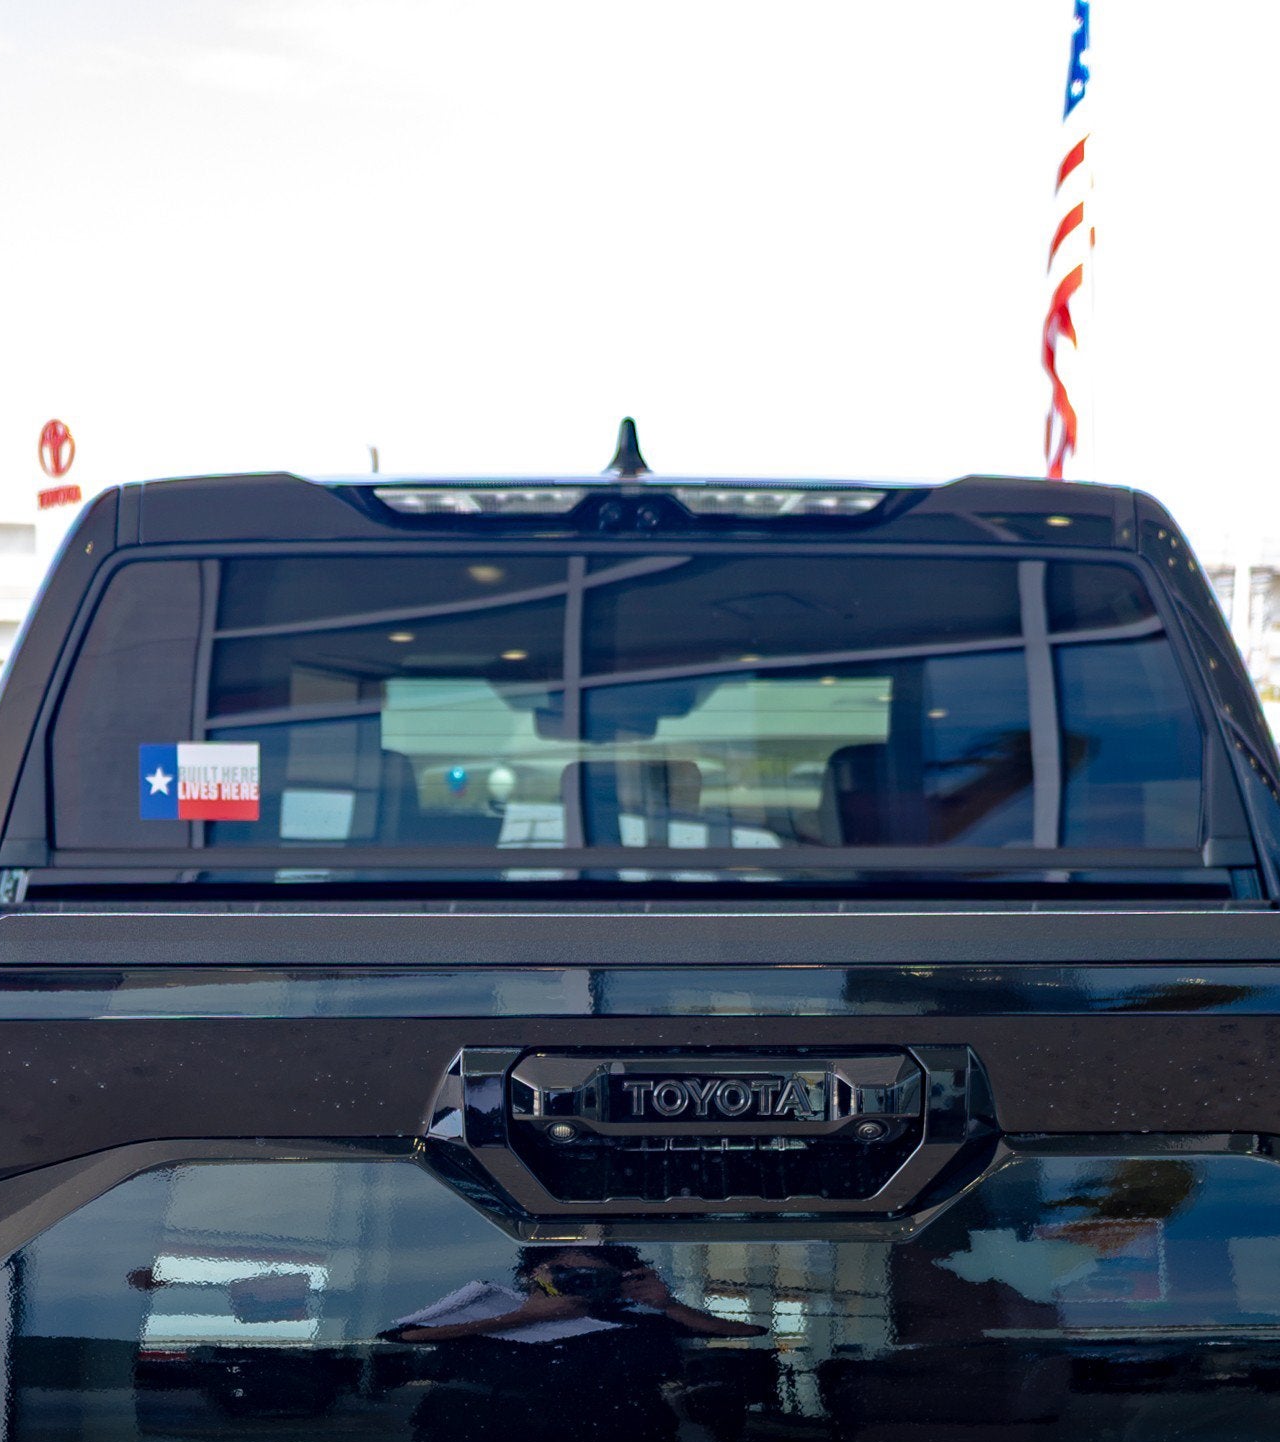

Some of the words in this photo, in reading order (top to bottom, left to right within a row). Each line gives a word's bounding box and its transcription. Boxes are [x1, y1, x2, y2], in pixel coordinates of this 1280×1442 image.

[178, 767, 218, 782] BUILT
[221, 767, 258, 782] HERE
[178, 783, 217, 800] LIVES
[221, 783, 258, 800] HERE
[623, 1079, 813, 1117] TOYOTA
